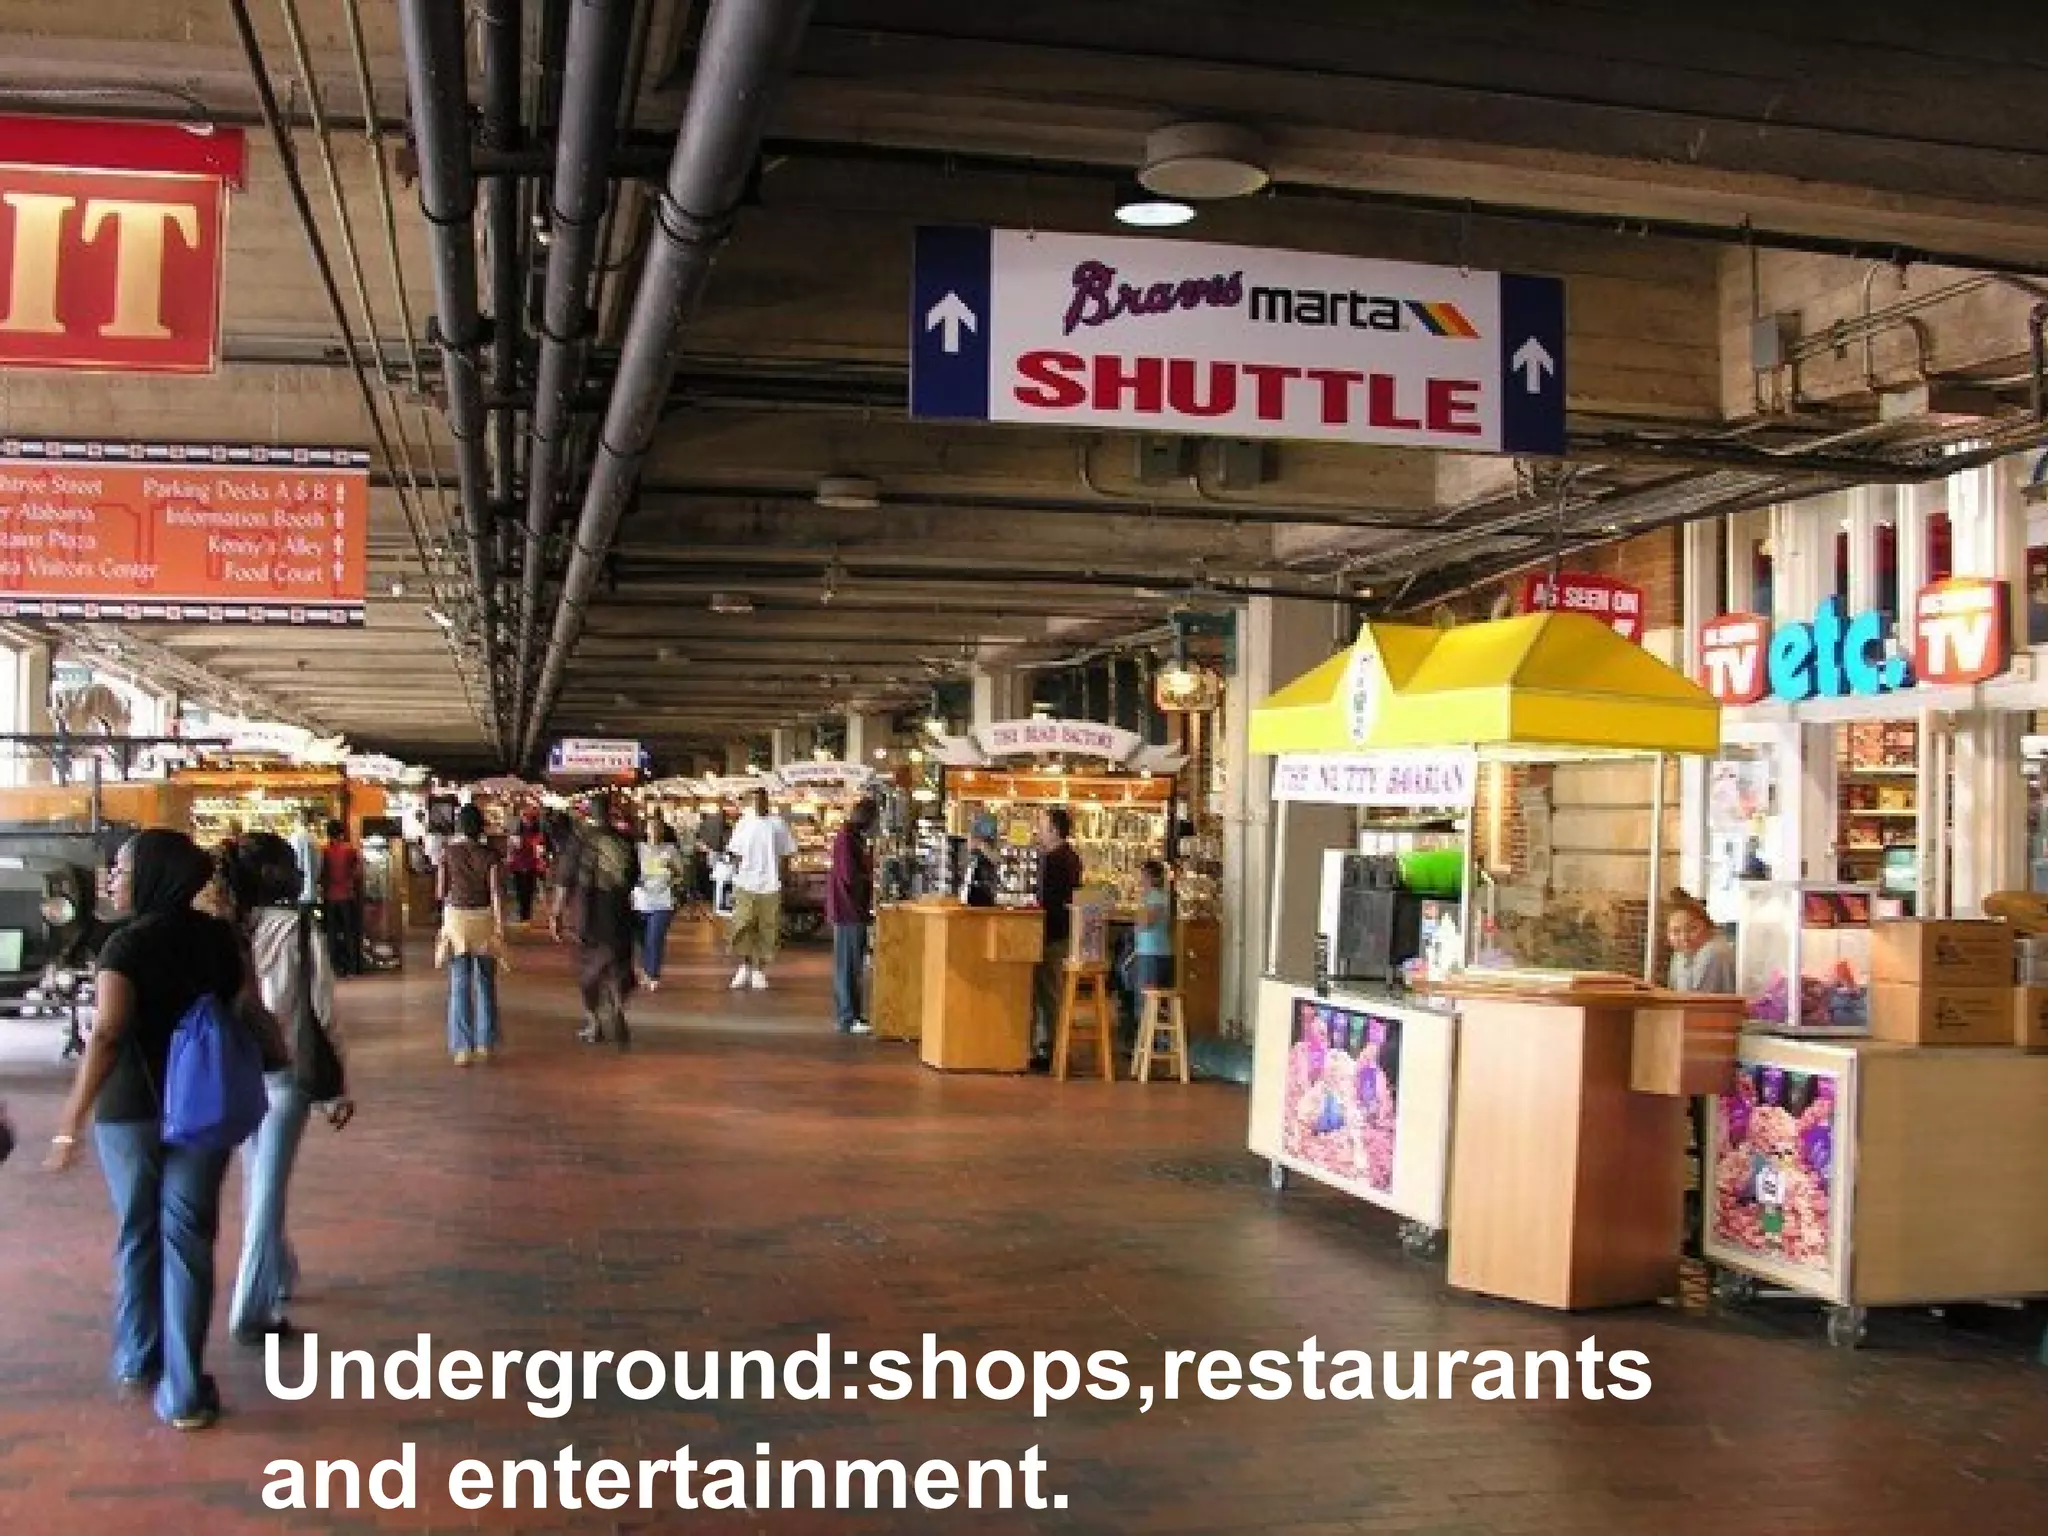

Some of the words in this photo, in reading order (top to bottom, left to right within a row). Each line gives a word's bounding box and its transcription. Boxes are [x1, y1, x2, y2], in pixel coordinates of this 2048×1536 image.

[0, 193, 198, 339] IT
[1249, 287, 1400, 331] marta
[1013, 350, 1482, 436] SHUTTLE
[143, 478, 210, 502] Parking
[217, 479, 269, 500] Decks
[166, 506, 267, 529] Information
[274, 508, 325, 528] Booth
[99, 558, 159, 580] Center
[224, 561, 269, 582] Food
[274, 563, 322, 583] Court
[1768, 594, 1908, 702] etc.
[1920, 613, 1992, 675] TV
[1703, 645, 1756, 697] TV
